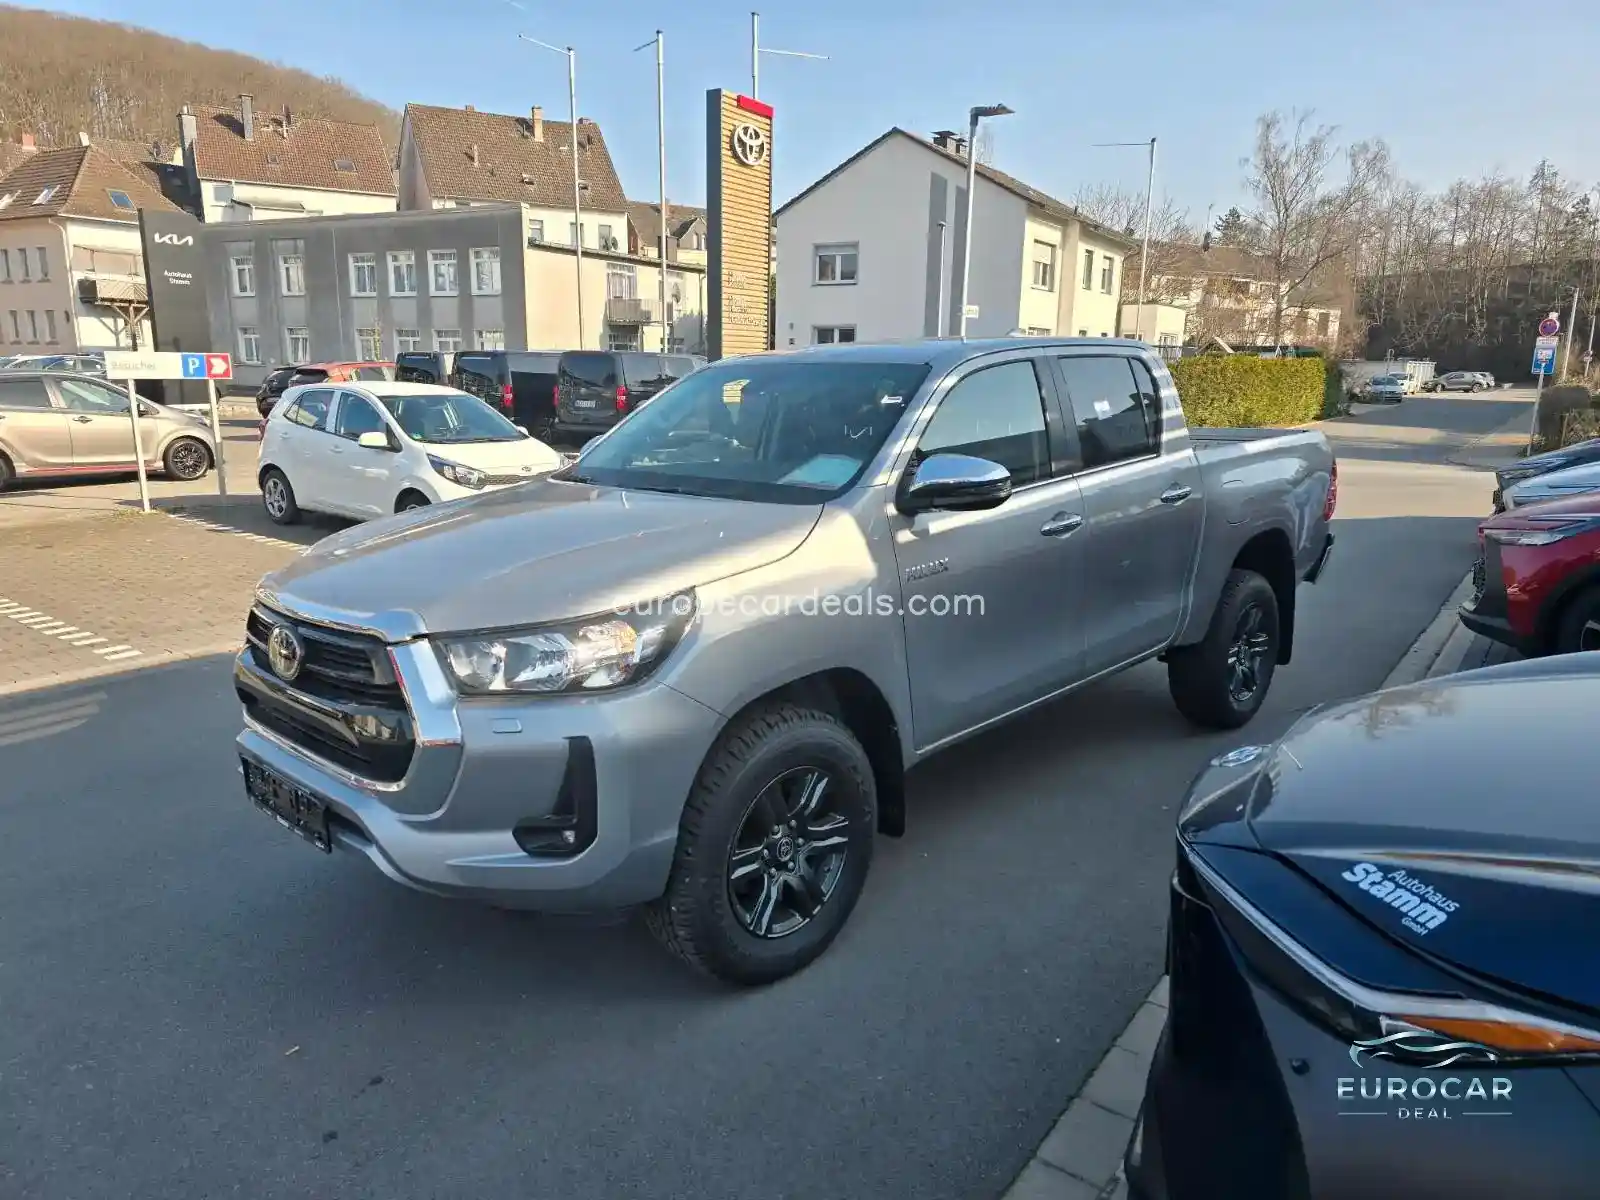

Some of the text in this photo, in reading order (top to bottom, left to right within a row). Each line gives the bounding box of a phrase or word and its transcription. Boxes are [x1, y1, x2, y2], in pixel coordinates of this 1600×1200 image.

[187, 356, 201, 375] P
[1341, 862, 1448, 930] Stamm
[1387, 869, 1460, 912] Autohaus
